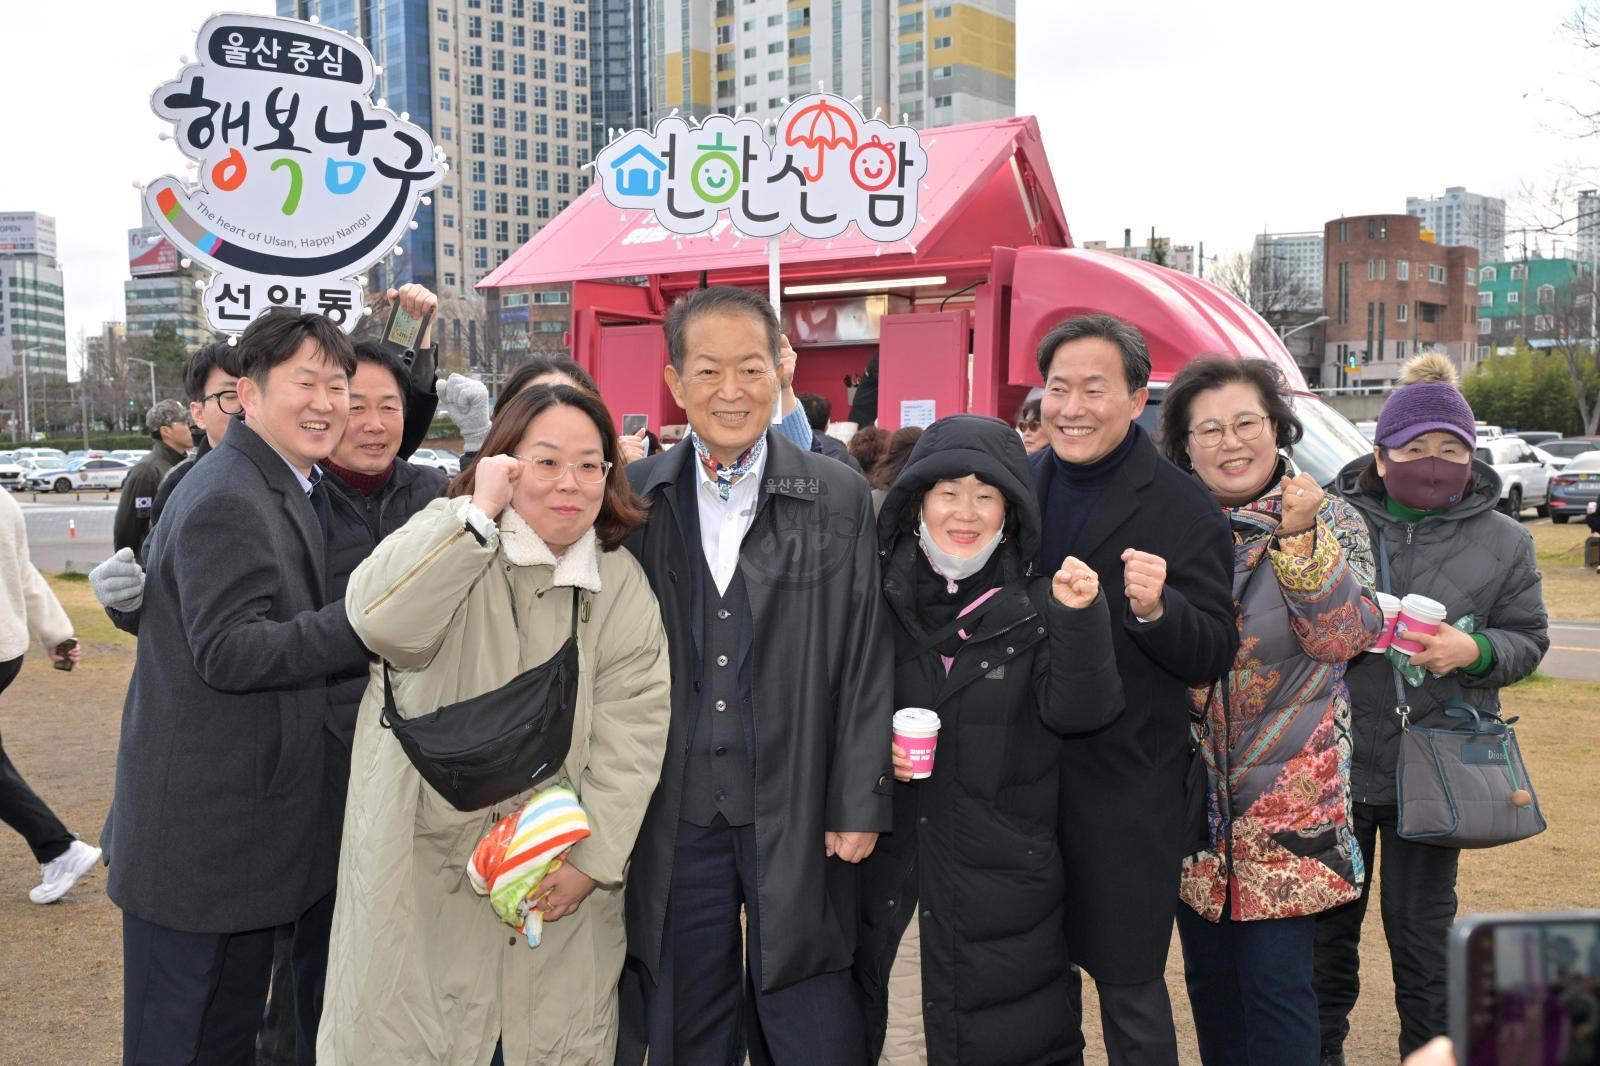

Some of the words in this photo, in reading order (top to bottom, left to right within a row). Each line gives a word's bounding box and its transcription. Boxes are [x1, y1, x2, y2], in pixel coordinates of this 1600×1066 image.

[221, 32, 281, 69] 울산
[287, 40, 344, 77] 중심
[197, 201, 215, 221] The
[216, 216, 246, 238] heart
[249, 231, 261, 242] of
[264, 235, 297, 249] Ulsan,
[301, 235, 335, 249] Happy
[336, 213, 372, 240] Namgu
